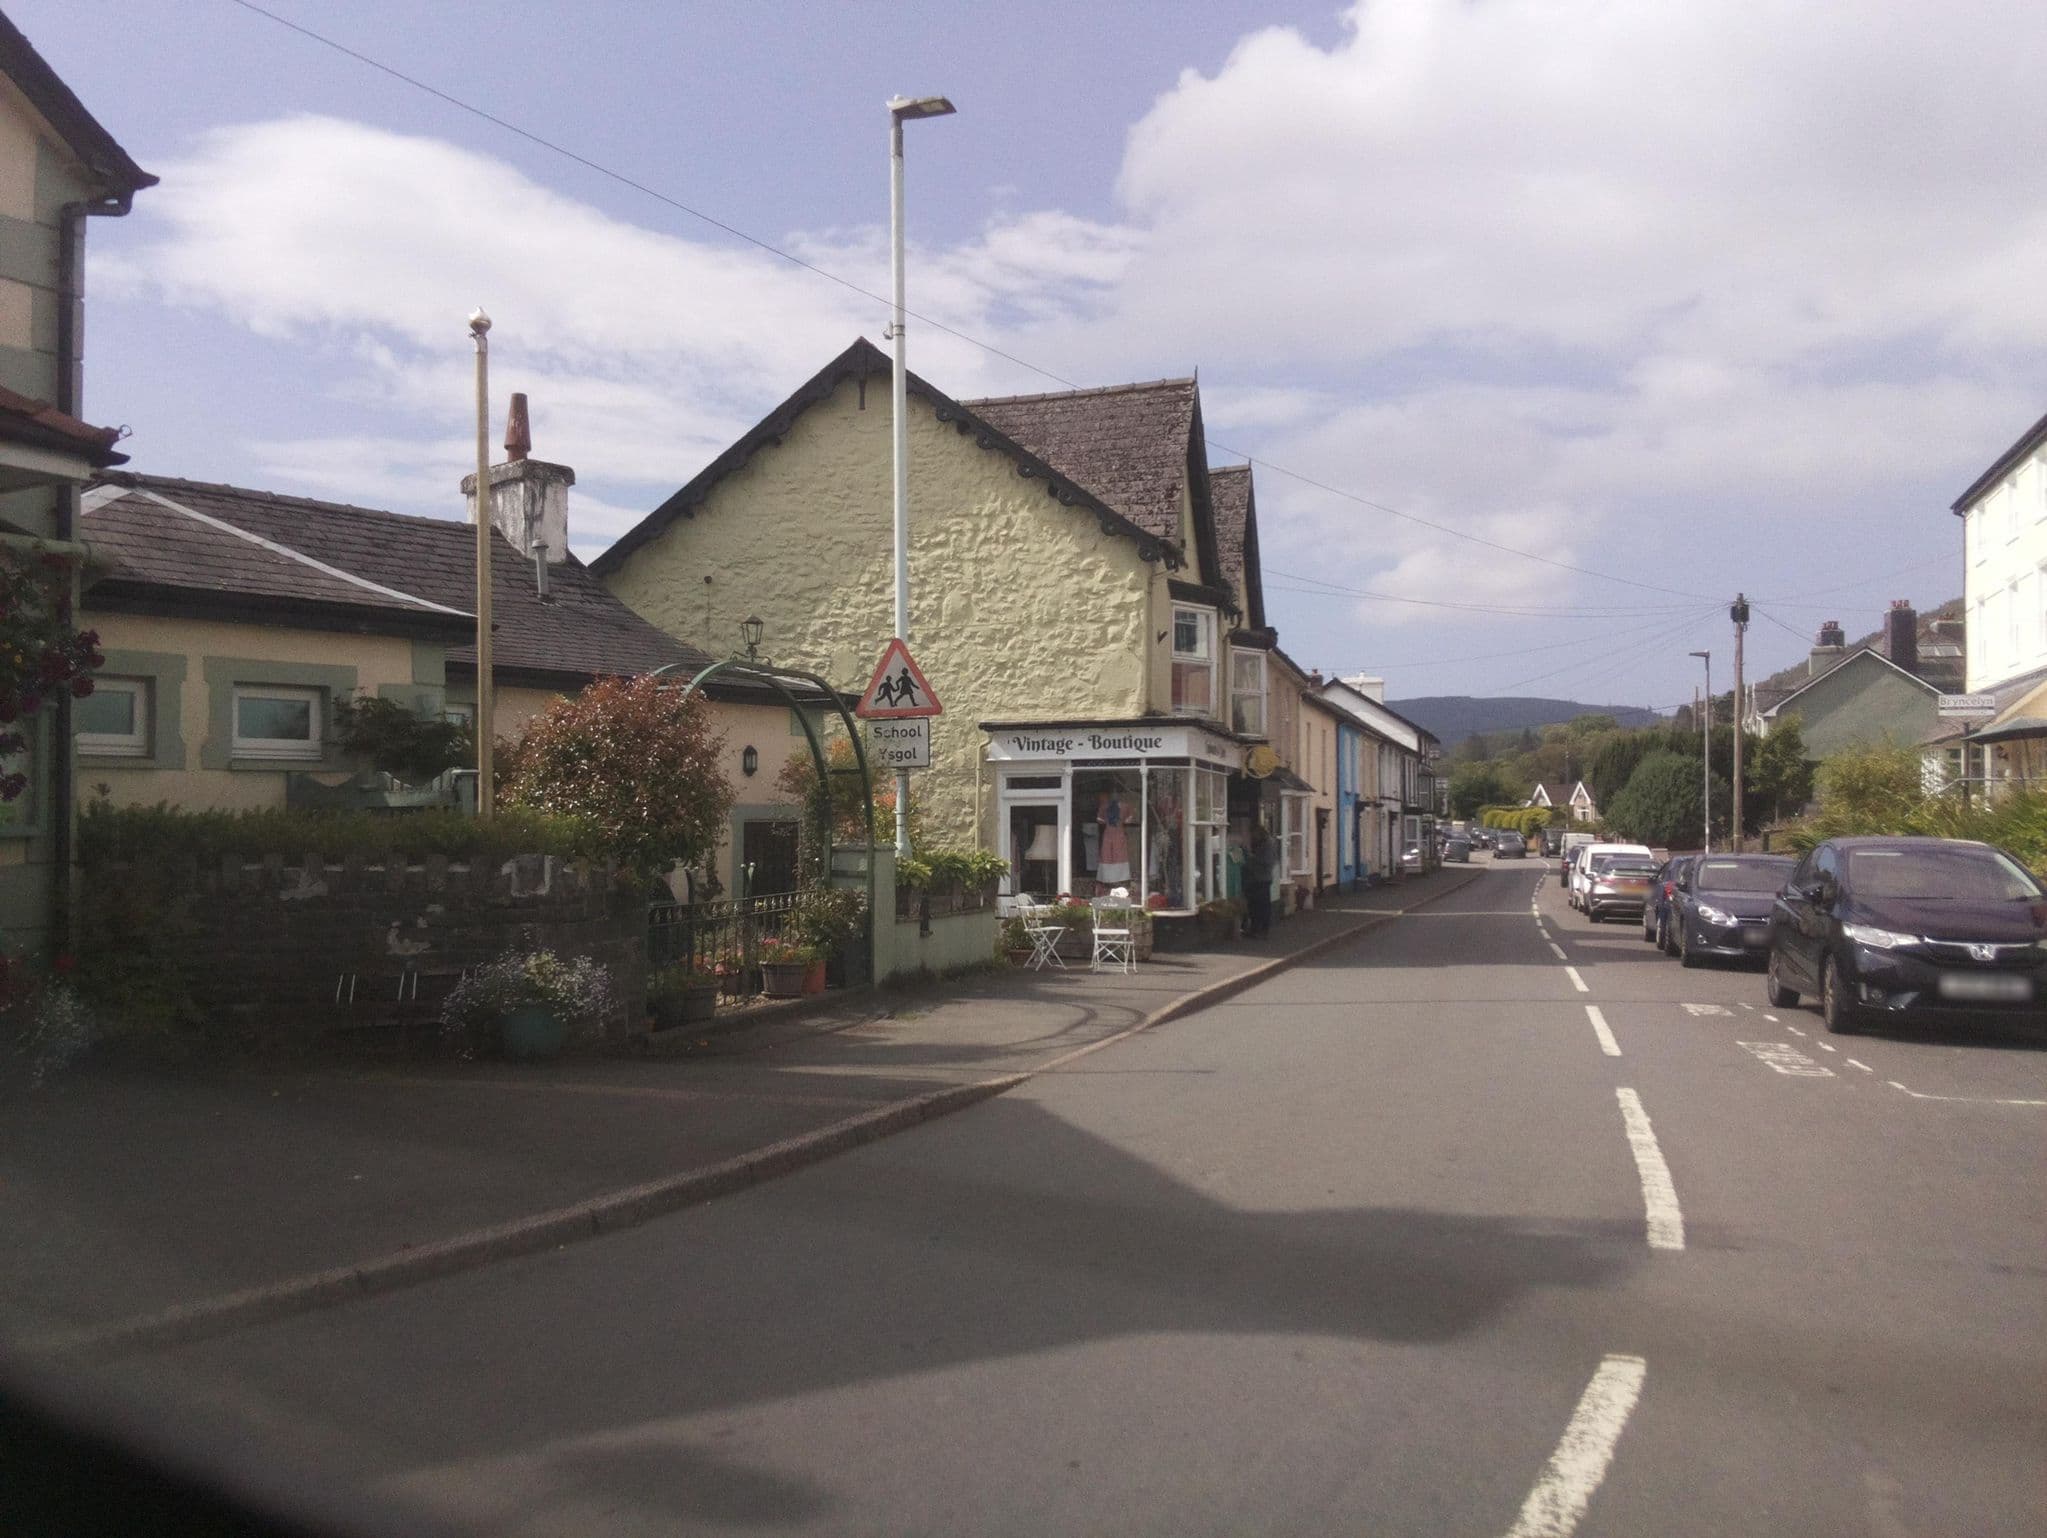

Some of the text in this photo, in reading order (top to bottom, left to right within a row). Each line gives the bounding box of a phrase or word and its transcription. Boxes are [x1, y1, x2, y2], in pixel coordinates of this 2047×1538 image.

[1940, 696, 1993, 706] Bryncelyn
[874, 726, 922, 738] School
[1012, 736, 1073, 755] Vintage
[1087, 734, 1163, 753] Boutique
[879, 747, 917, 762] Ysgol
